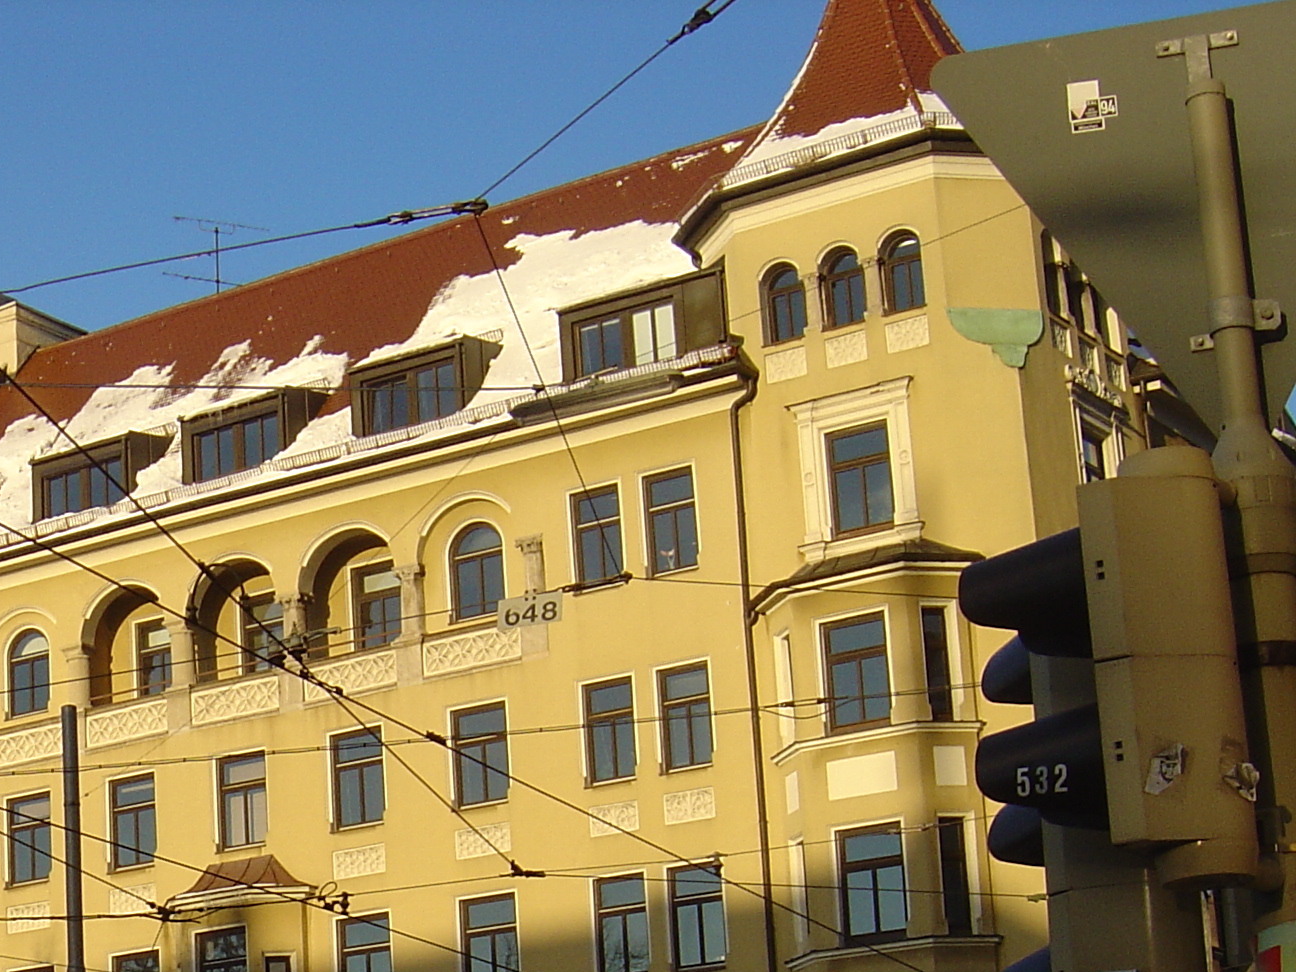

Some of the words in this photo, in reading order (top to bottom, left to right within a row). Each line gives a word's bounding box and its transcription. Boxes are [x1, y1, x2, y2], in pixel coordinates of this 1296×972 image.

[1100, 98, 1116, 115] 94
[504, 601, 558, 626] 648
[1016, 763, 1069, 798] 532
